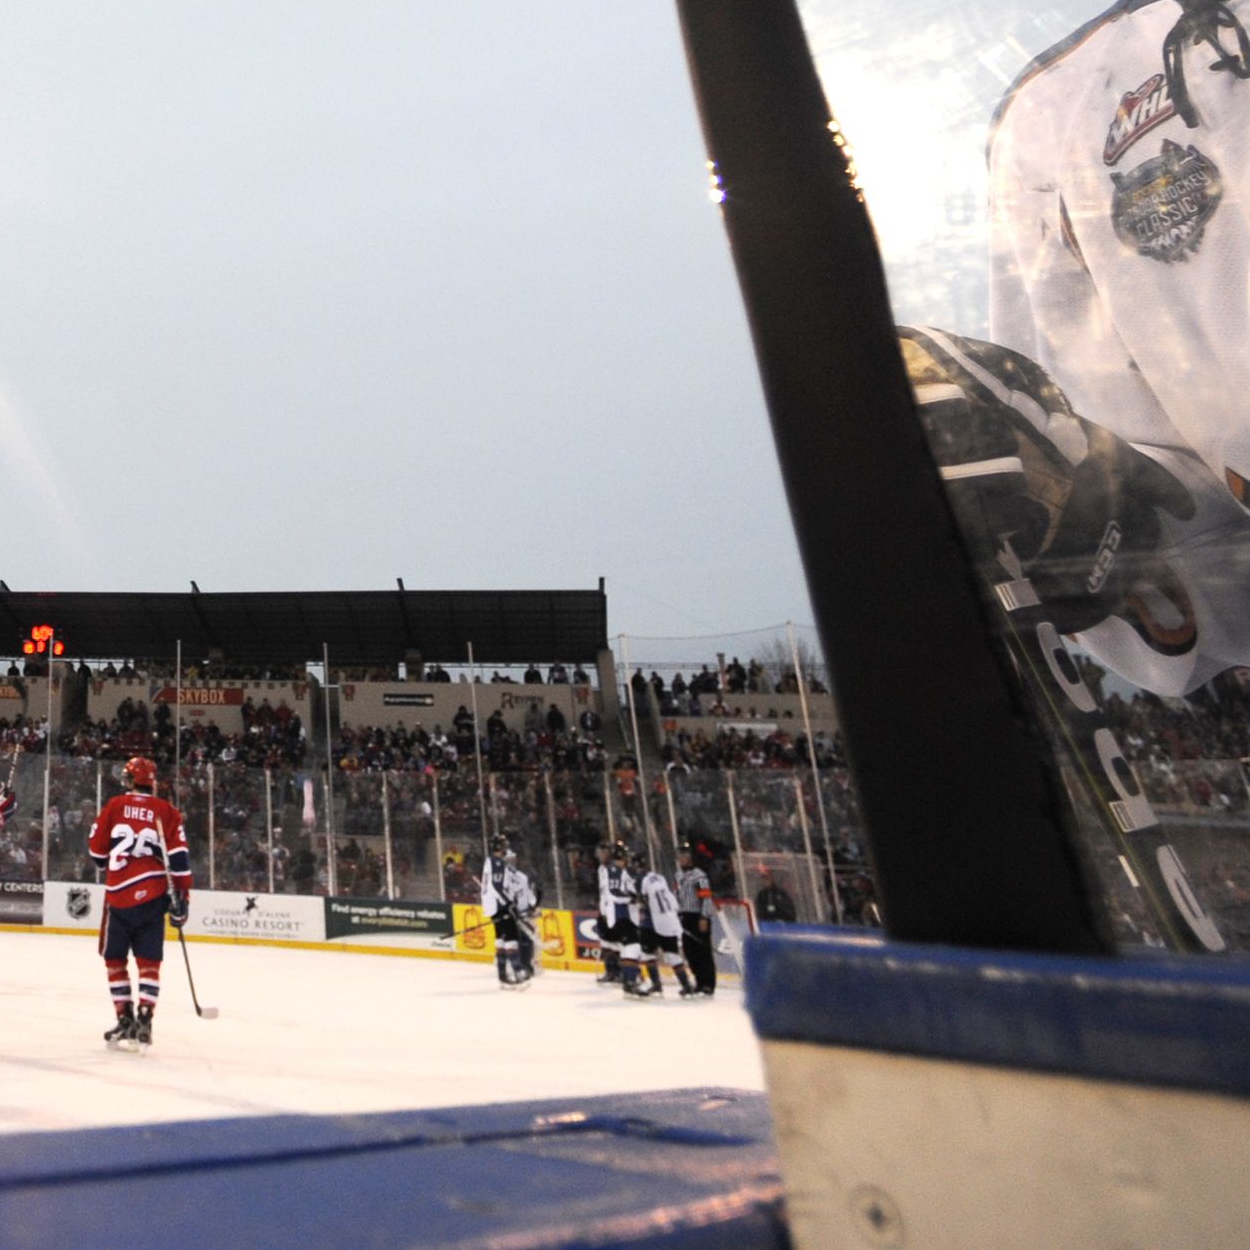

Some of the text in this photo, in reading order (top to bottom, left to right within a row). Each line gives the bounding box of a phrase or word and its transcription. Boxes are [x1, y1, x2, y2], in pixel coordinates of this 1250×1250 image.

[1161, 170, 1212, 202] HOCKEY
[1136, 196, 1199, 242] CLASSIC
[178, 688, 226, 704] SKYBOX
[123, 805, 154, 822] UHER
[202, 917, 301, 931] CASINO RESORT
